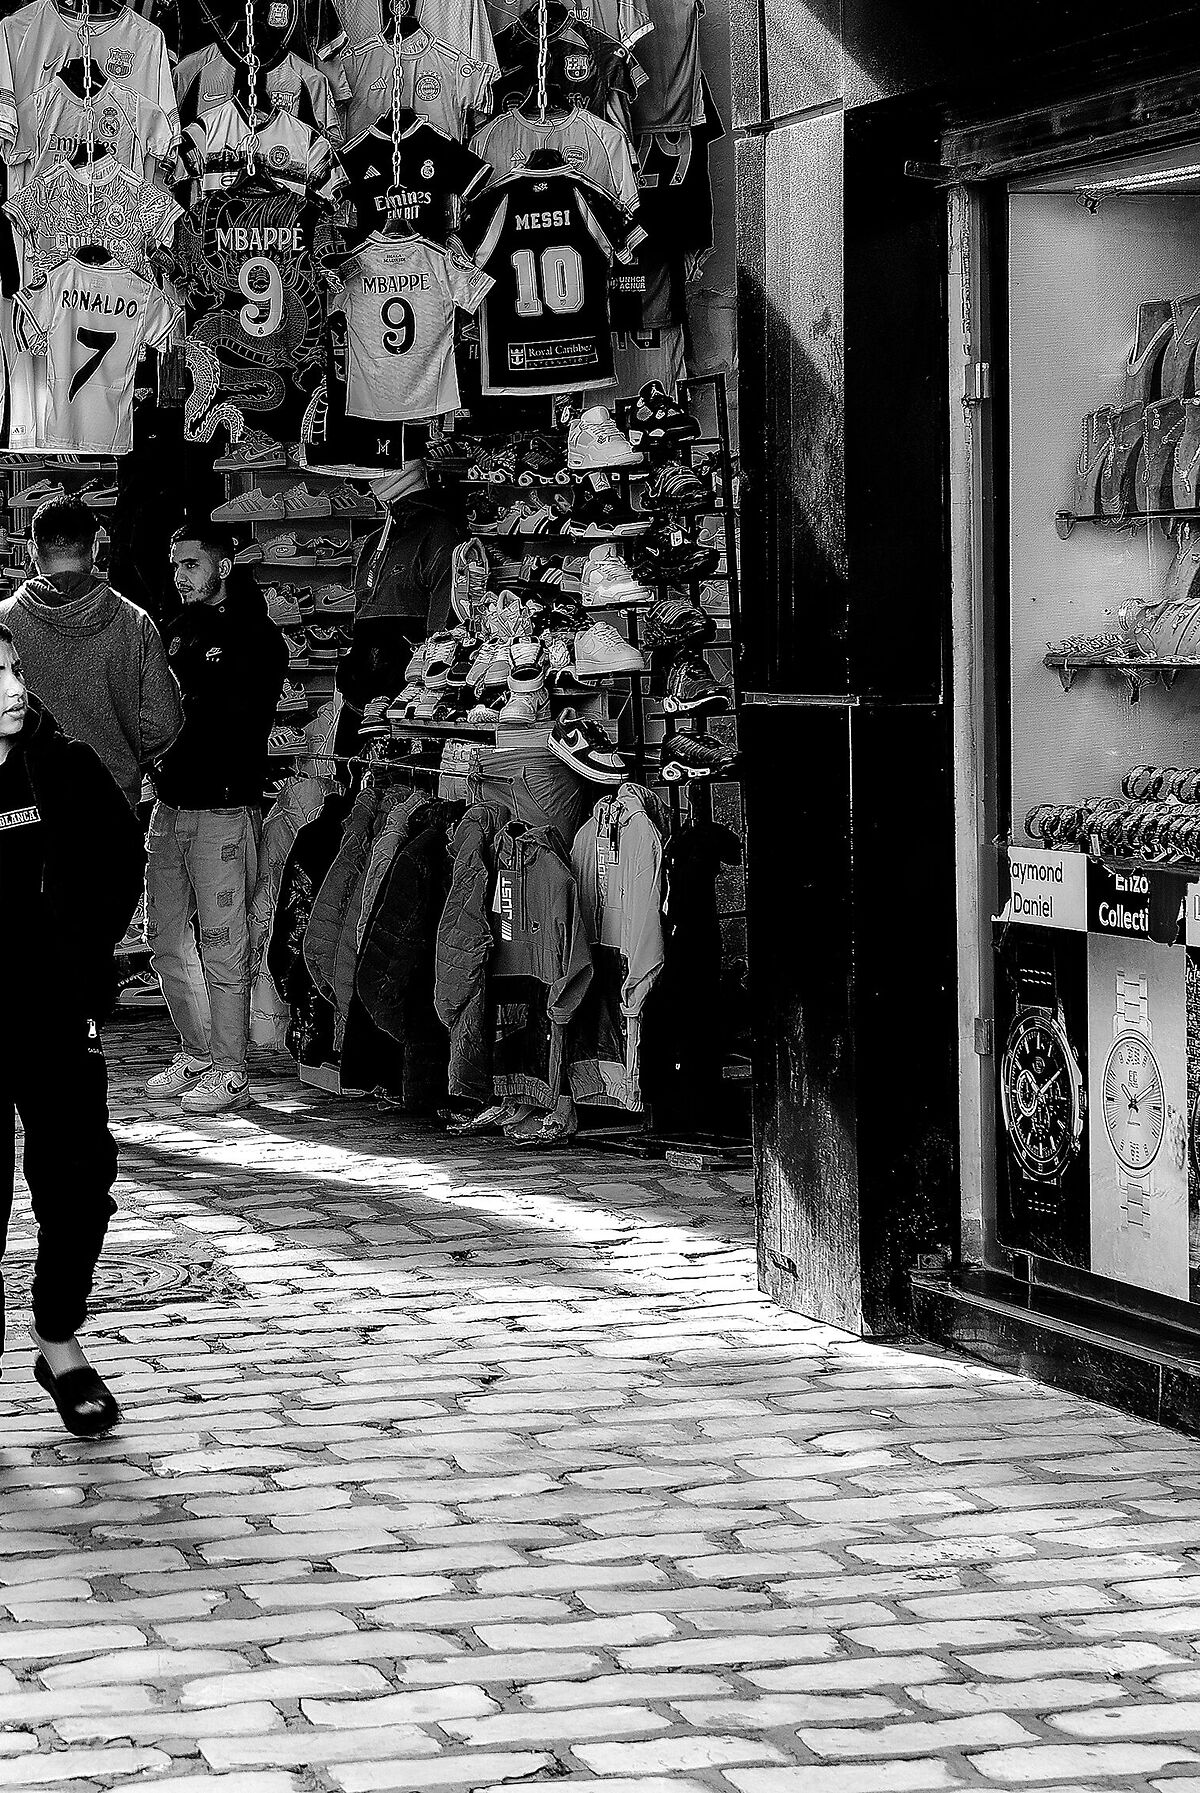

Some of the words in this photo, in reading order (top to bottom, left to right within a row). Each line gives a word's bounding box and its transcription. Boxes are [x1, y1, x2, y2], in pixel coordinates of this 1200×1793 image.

[515, 209, 571, 231] MESSI
[216, 222, 306, 251] MBAPPÉ
[362, 272, 433, 295] MBAPPE
[511, 246, 585, 317] 10
[61, 288, 139, 319] RONALDO
[238, 257, 284, 338] 9
[380, 296, 417, 356] 9
[68, 326, 118, 404] 7
[528, 346, 553, 360] Royal
[1011, 862, 1063, 884] aymond
[502, 877, 512, 920] JUST
[1013, 891, 1053, 918] Daniel
[1099, 901, 1149, 932] Collecti
